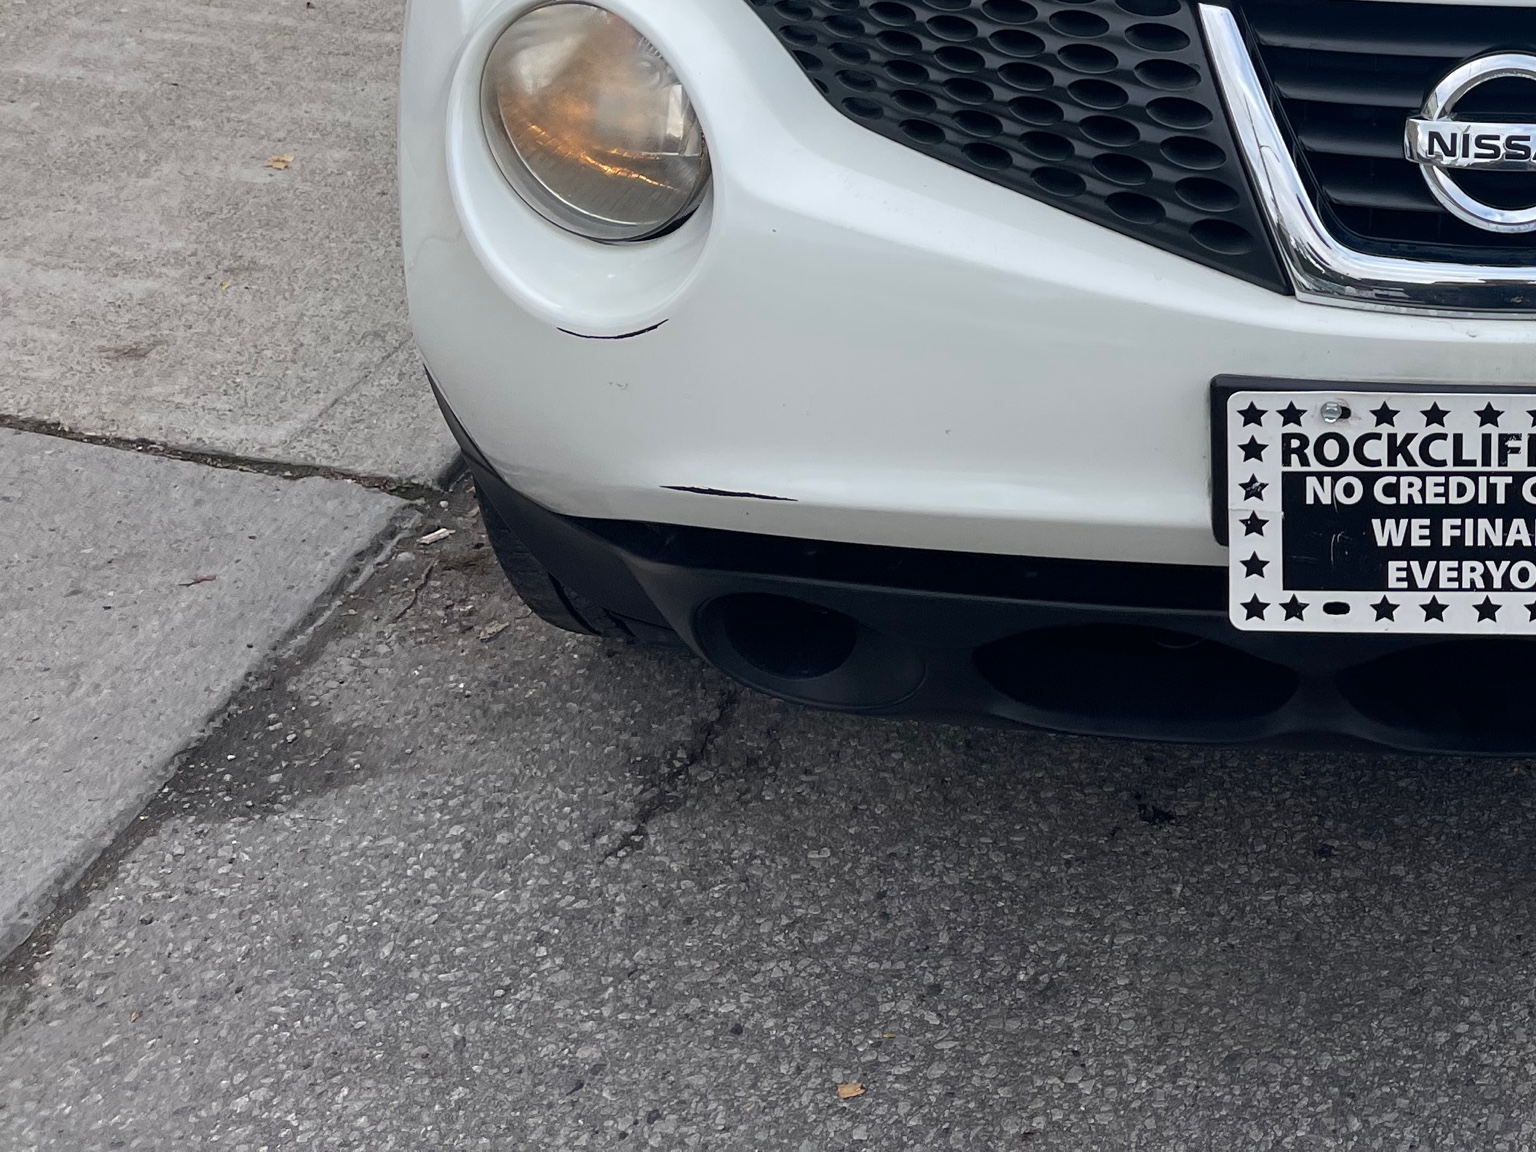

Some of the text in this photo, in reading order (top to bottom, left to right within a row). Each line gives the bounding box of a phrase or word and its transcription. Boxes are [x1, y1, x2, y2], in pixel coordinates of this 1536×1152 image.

[1306, 476, 1363, 505] NO
[1374, 475, 1513, 505] CREDIT
[1372, 518, 1430, 547] WE
